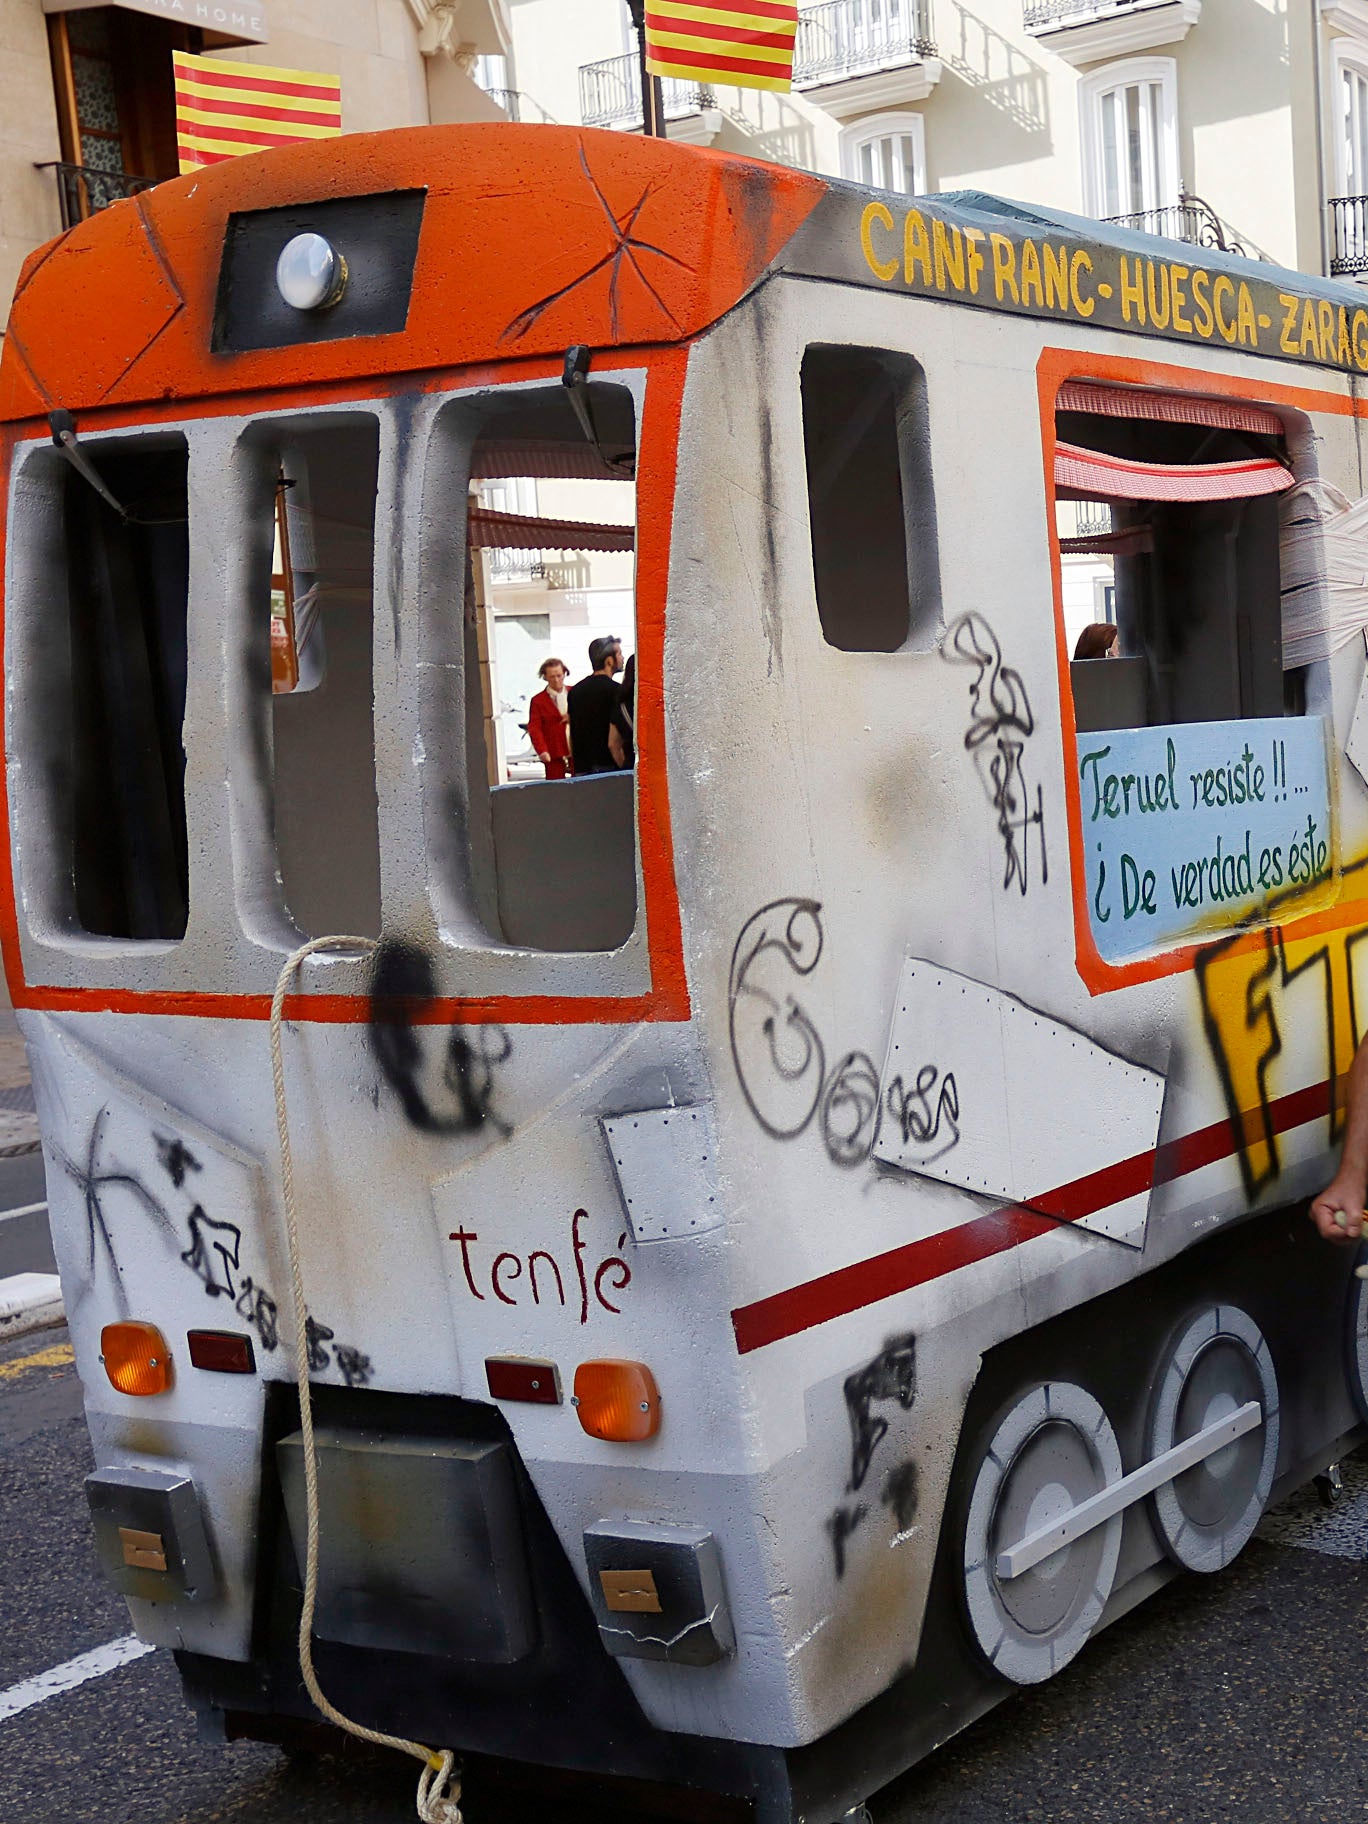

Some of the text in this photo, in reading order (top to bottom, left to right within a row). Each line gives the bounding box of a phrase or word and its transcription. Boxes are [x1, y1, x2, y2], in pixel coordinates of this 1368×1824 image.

[197, 5, 262, 31] HOME
[1080, 737, 1180, 821] Teruel
[1171, 830, 1255, 909] verdad
[1256, 846, 1282, 889] es
